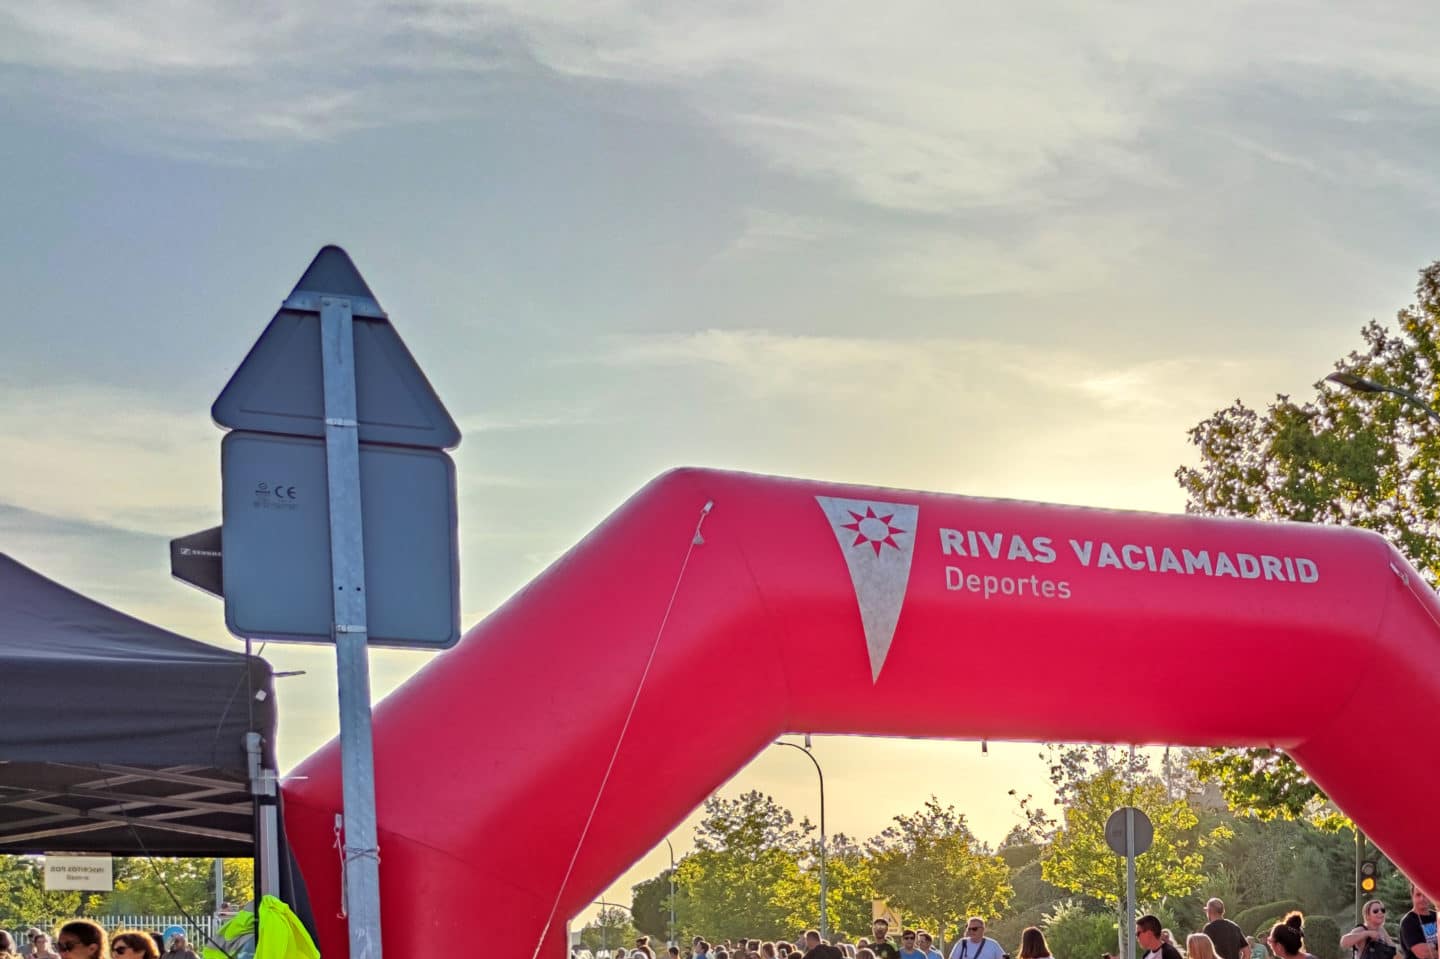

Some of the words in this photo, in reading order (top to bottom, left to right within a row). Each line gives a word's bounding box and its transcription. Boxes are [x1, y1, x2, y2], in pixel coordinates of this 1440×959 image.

[939, 528, 1057, 563] RIVAS
[1069, 540, 1319, 583] VACIAMADRID
[945, 565, 1072, 599] Deportes
